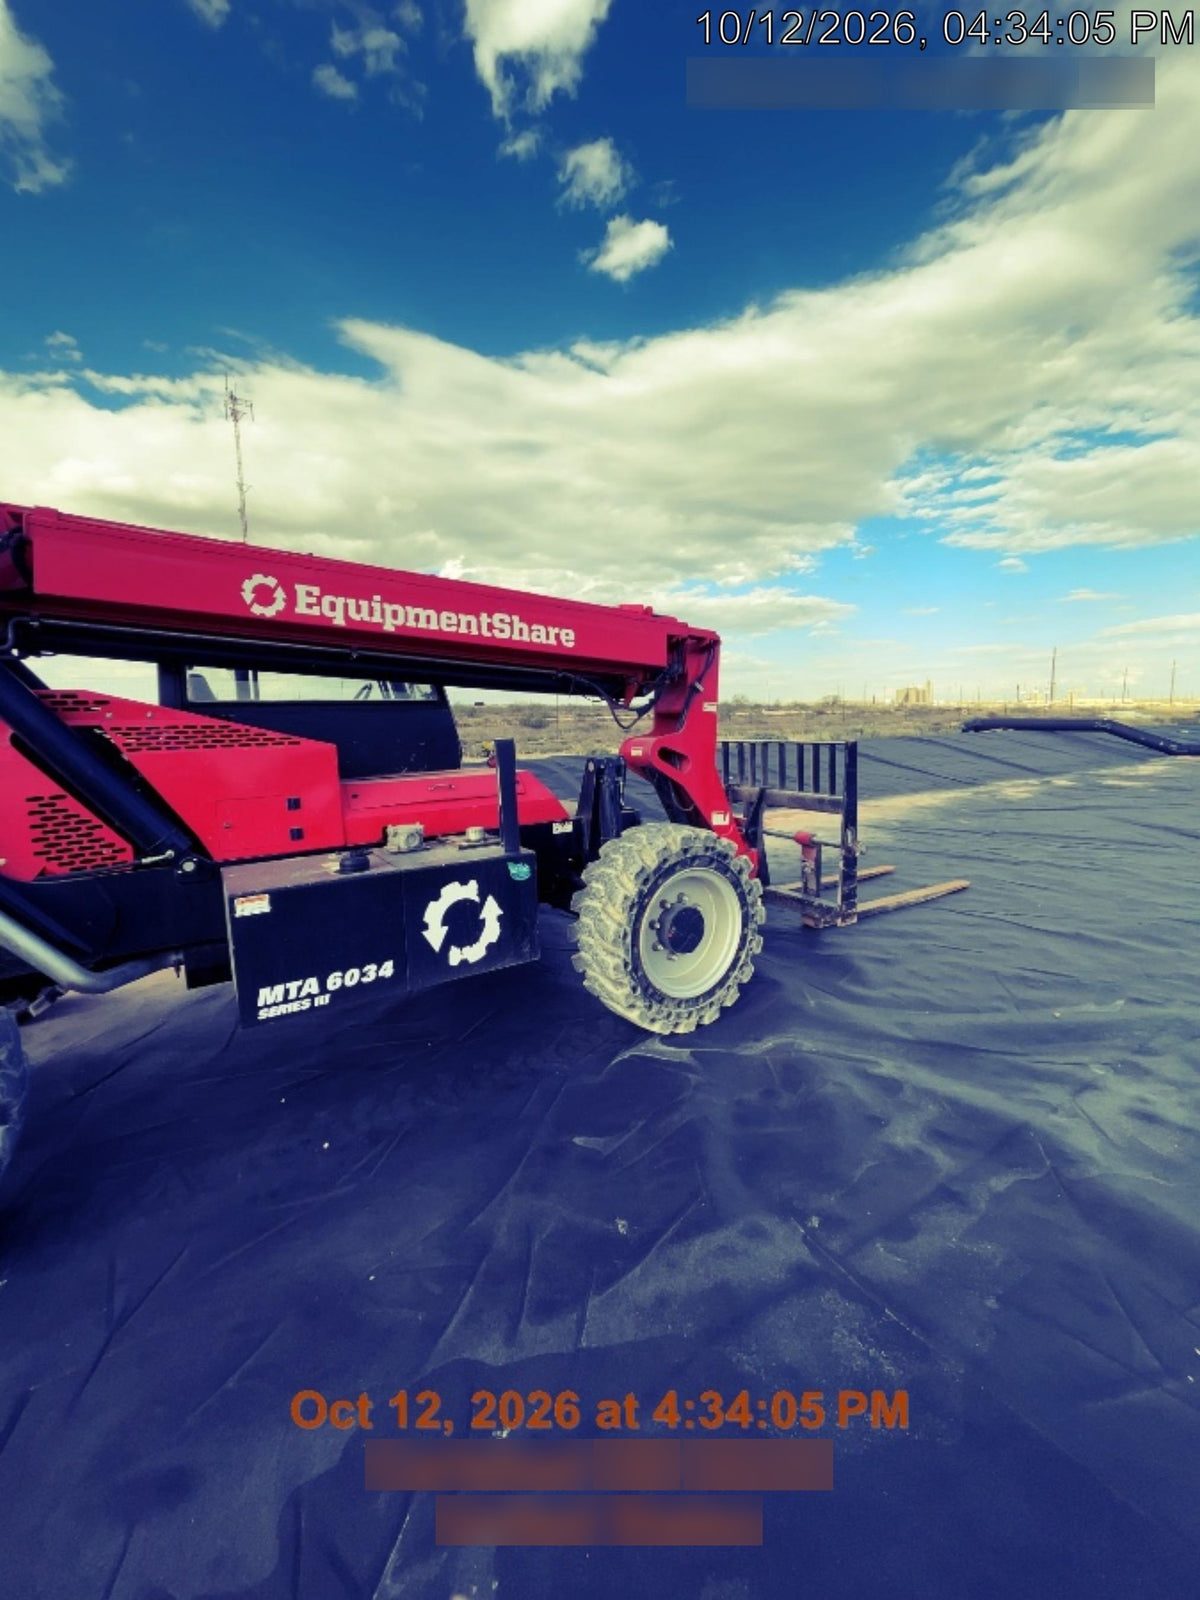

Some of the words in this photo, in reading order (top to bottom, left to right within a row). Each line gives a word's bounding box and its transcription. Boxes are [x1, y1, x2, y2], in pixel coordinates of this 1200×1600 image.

[294, 583, 576, 648] EquipmentShare
[257, 977, 320, 1007] MTA
[326, 959, 394, 991] 6034
[257, 998, 311, 1020] SERIES
